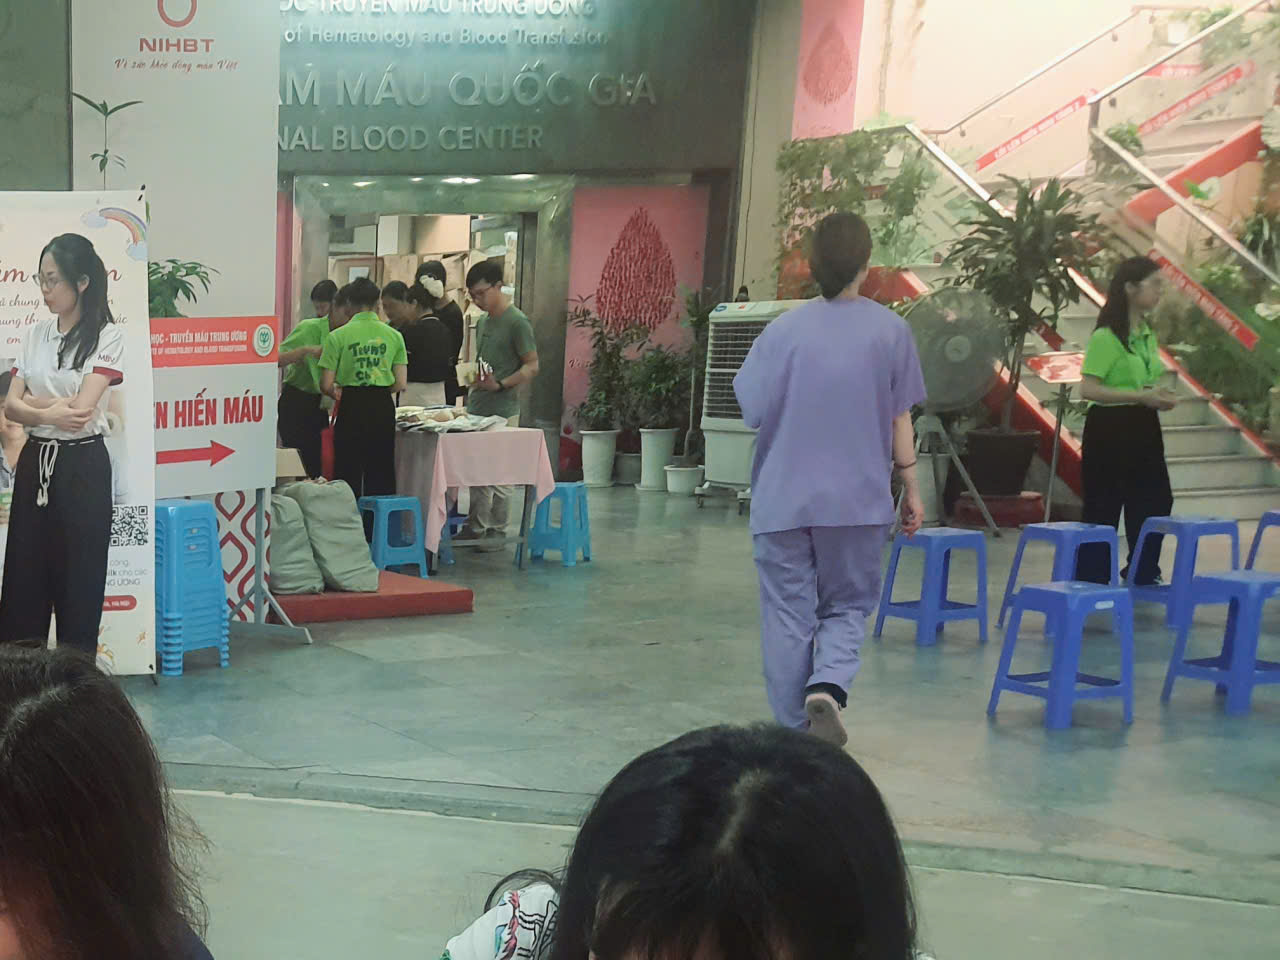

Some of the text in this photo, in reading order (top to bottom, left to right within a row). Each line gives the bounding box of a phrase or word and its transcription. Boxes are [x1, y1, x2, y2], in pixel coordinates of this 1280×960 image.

[139, 38, 214, 52] NIHBT
[285, 24, 608, 47] of Hematology and Blood Transfusion
[336, 63, 432, 106] MÁU
[449, 59, 571, 106] QUỐC
[589, 71, 657, 106] GIA
[332, 125, 429, 151] BLOOD
[438, 125, 544, 151] CENTER
[9, 294, 40, 310] chung
[174, 388, 217, 428] HIẾN
[223, 389, 264, 424] MÁU
